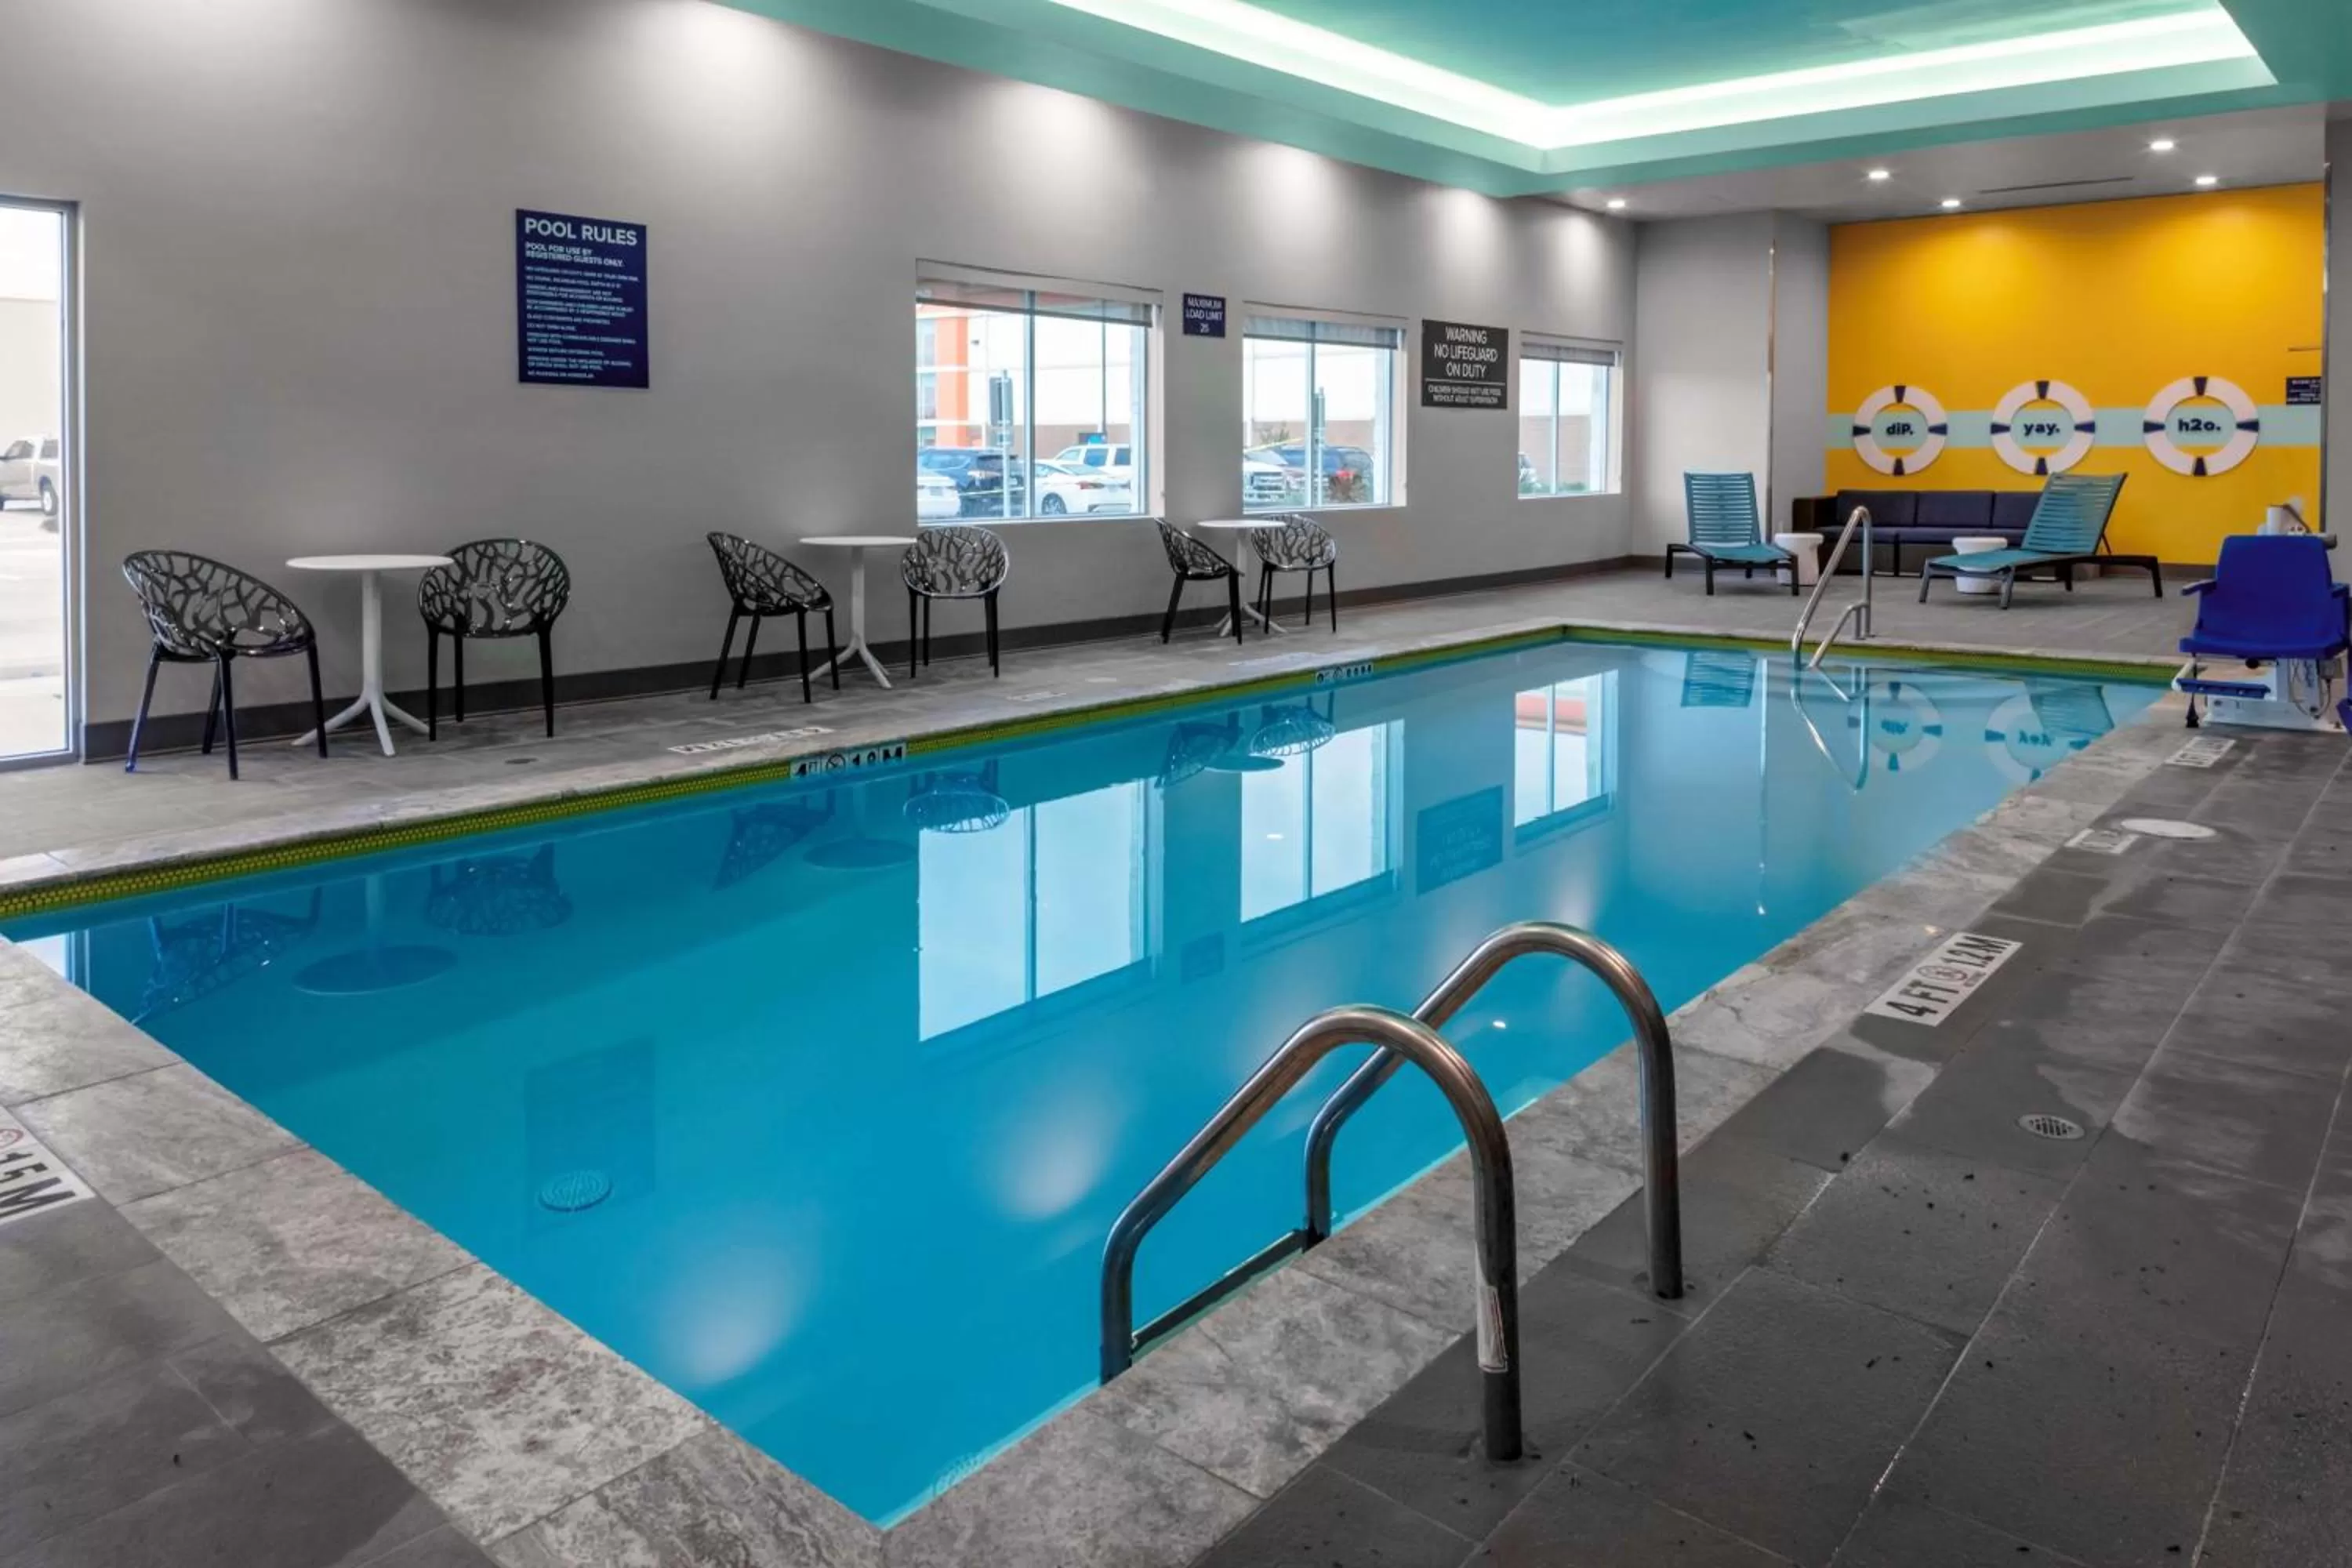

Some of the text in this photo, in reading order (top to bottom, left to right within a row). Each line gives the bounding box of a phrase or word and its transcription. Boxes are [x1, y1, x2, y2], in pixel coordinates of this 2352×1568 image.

[524, 216, 638, 246] POOL RULES
[524, 241, 547, 252] POOL
[548, 245, 564, 253] FOR
[566, 246, 581, 255] USE
[524, 250, 573, 261] REGISTERED
[573, 255, 603, 265] GUESTS
[1187, 296, 1222, 309] MAXIMUM
[1185, 307, 1224, 321] LOAD LIMIT
[1444, 325, 1487, 345] WARNING
[1433, 343, 1498, 362] NO LIFEGUARD
[1445, 360, 1487, 379] ON DUTY
[2023, 423, 2060, 437] yay.
[2177, 417, 2221, 431] h2o.
